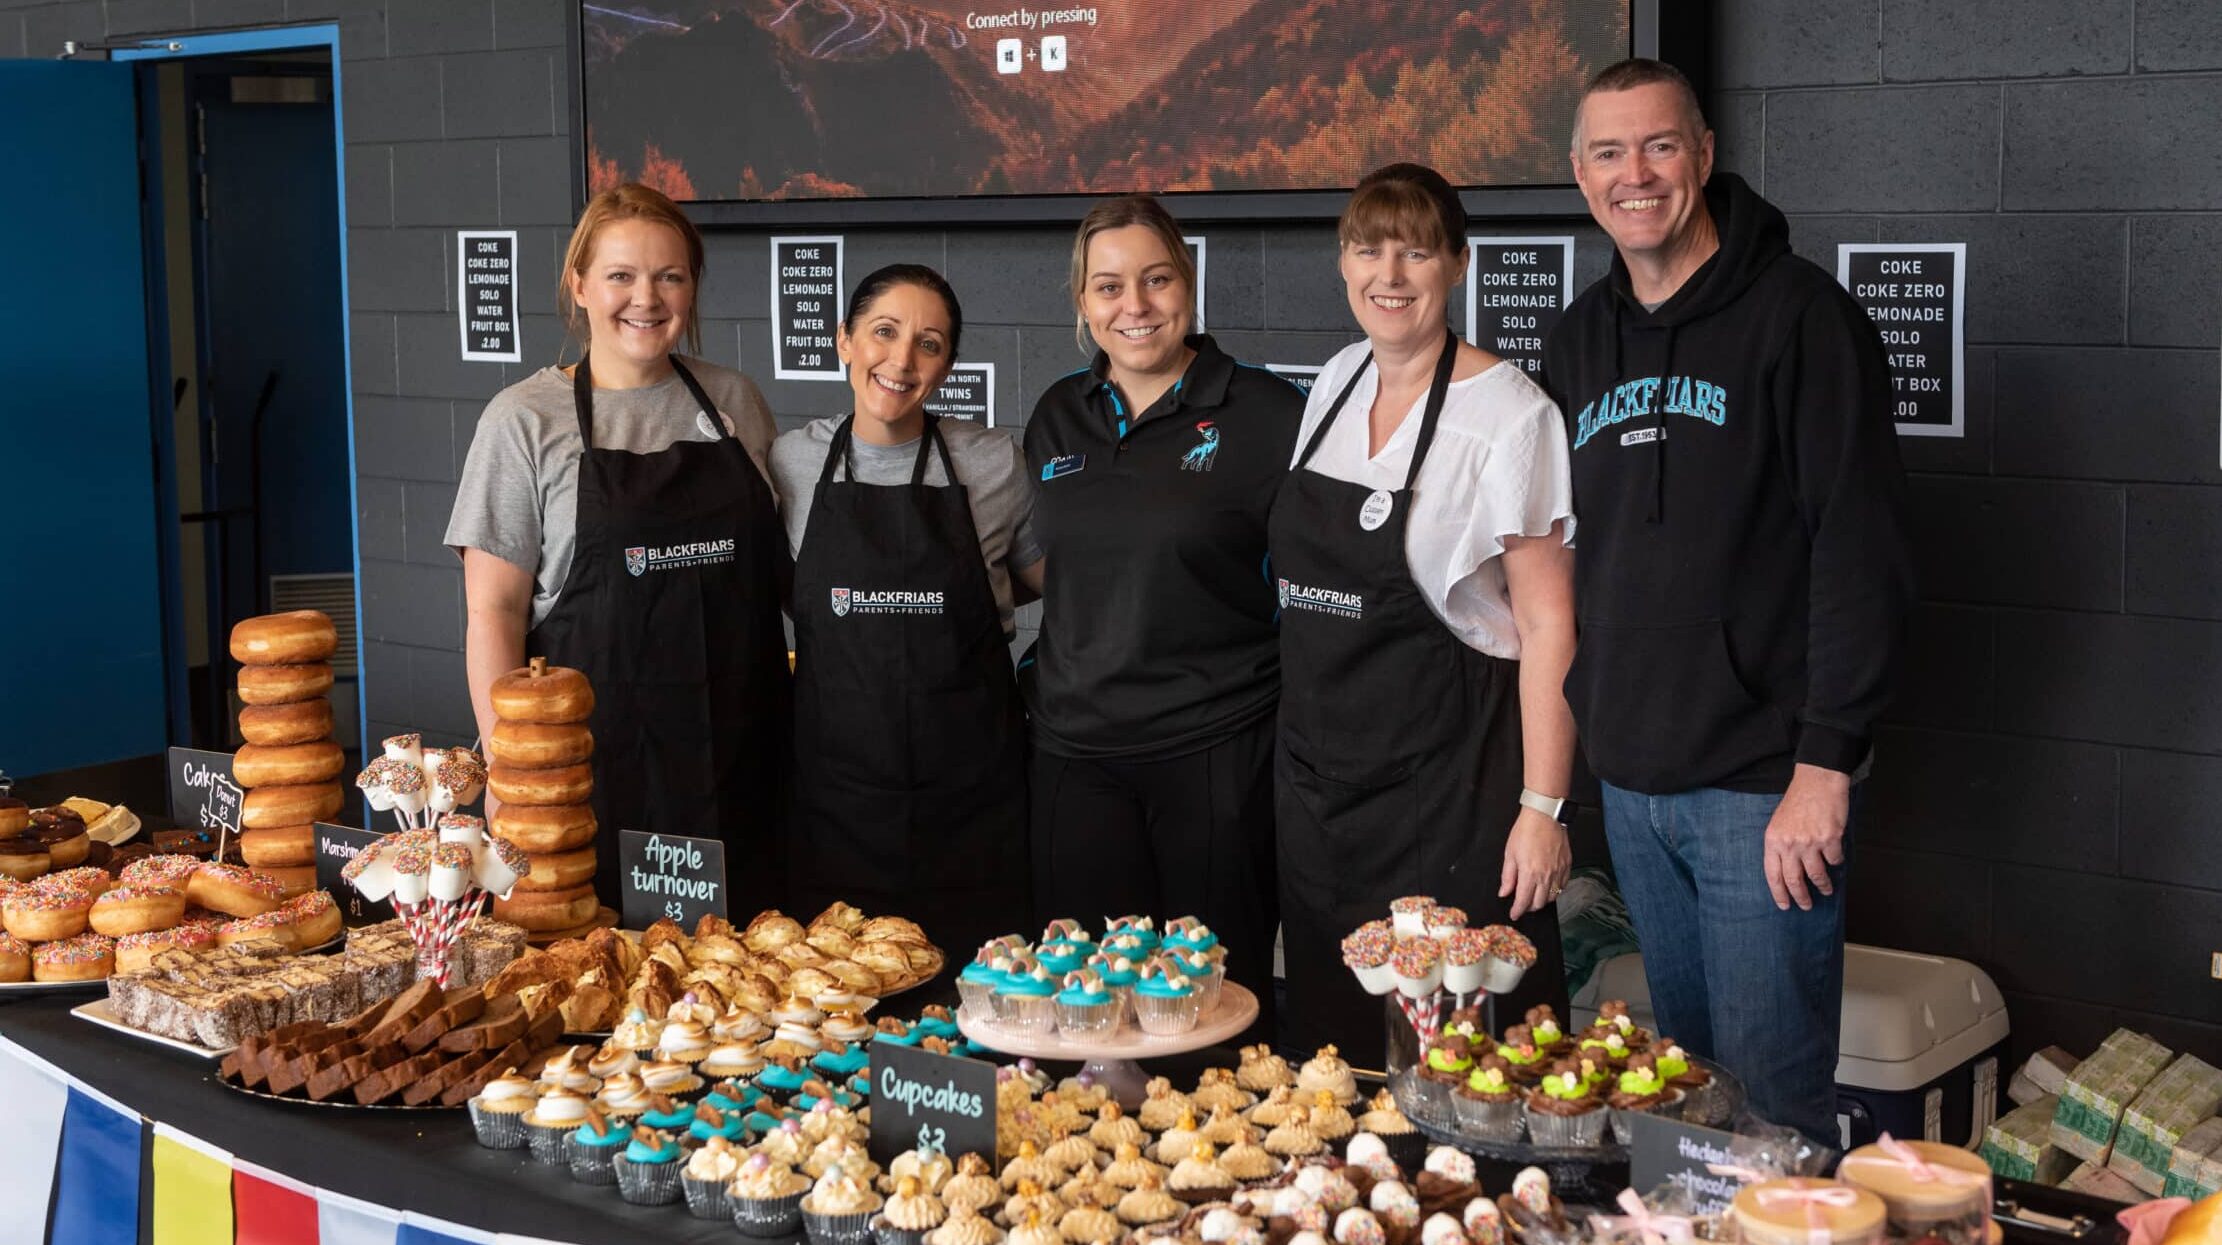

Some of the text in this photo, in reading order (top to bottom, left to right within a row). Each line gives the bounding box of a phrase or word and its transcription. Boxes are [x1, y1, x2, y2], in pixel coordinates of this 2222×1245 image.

[966, 4, 1097, 30] Connect by pressing
[1050, 47, 1058, 60] K
[478, 242, 498, 252] COKE
[795, 248, 820, 260] COKE
[1502, 252, 1537, 265] COKE
[468, 258, 510, 268] COKE ZERO
[1880, 260, 1922, 274] COKE
[782, 266, 833, 277] COKE ZERO
[468, 274, 510, 284] LEMONADE
[1483, 273, 1557, 286] COKE ZERO
[480, 290, 500, 300] SOLO
[783, 284, 833, 295] LEMONADE
[1857, 284, 1945, 298] COKE ZERO
[796, 301, 820, 312] SOLO
[1483, 295, 1557, 307] LEMONADE
[477, 305, 503, 316] WATER
[1867, 307, 1945, 321] EMONADE
[471, 321, 510, 332] FRUIT BOX
[793, 318, 824, 330] WATER
[1502, 316, 1536, 329] SOLO
[786, 335, 833, 348] FRUIT BOX
[1497, 337, 1542, 350] WATER
[1880, 331, 1920, 344] SOLO
[1888, 354, 1926, 368] ATER
[957, 375, 981, 383] NORTH
[1910, 378, 1941, 392] BOX
[939, 388, 972, 399] TWINS
[1893, 401, 1918, 416] .00
[647, 539, 735, 560] BLACKFRIARS
[852, 591, 944, 604] BLACKFRIARS
[1290, 584, 1362, 608] BLACKFRIARS
[184, 762, 225, 787] Cak
[216, 785, 236, 807] Donut
[219, 804, 228, 820] $3
[644, 833, 704, 876] Apple
[630, 865, 719, 902] turnover
[350, 897, 362, 916] $1
[665, 900, 684, 922] $3
[881, 1066, 983, 1118] Cupcakes
